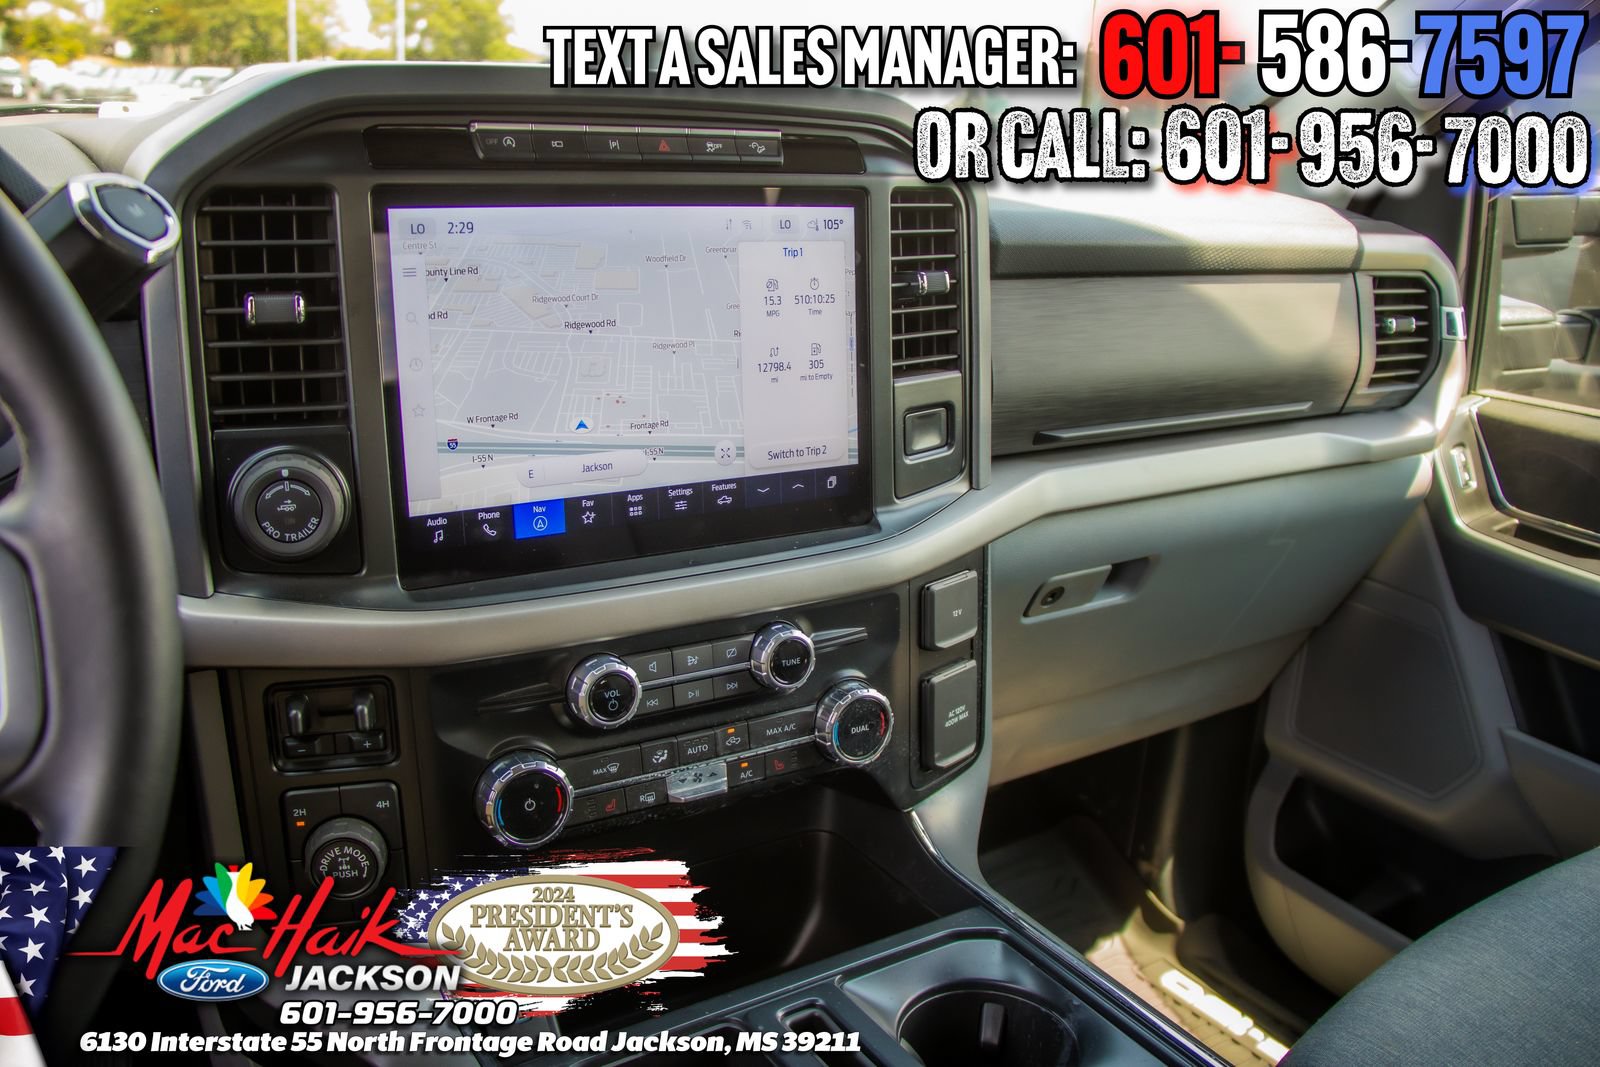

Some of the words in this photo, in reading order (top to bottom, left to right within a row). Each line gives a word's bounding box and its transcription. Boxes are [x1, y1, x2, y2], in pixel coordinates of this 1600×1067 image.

[410, 223, 425, 235] LO
[447, 221, 474, 235] 2:29
[780, 220, 791, 229] LO
[402, 241, 427, 250] Centre
[428, 241, 437, 249] St
[783, 248, 799, 257] Trip
[645, 255, 678, 263] Woodfield
[449, 267, 466, 275] Line
[467, 266, 479, 275] Rd
[532, 295, 571, 304] Ridgewood
[571, 294, 588, 302] Court
[589, 293, 599, 301] Dr
[764, 296, 782, 305] 15.3
[795, 294, 835, 304] 510:10:25
[437, 310, 448, 319] Rd
[564, 321, 605, 330] Ridgewood
[606, 320, 616, 328] Rd
[652, 341, 686, 350] Ridgewood
[758, 362, 792, 373] 12798.4
[809, 360, 824, 369] 305
[815, 373, 832, 381] Empty
[467, 416, 474, 424] W
[475, 414, 508, 424] Frontage
[509, 412, 519, 421] Rd
[630, 421, 659, 430] Frontage
[660, 420, 669, 428] Rd
[768, 449, 794, 461] Switch
[796, 449, 804, 457] to
[806, 446, 821, 458] Trip
[822, 446, 827, 455] 2
[472, 454, 486, 463] I-55
[582, 461, 613, 473] Jackson
[528, 470, 534, 479] E
[711, 482, 737, 491] Features
[668, 487, 693, 498] Settings
[582, 499, 594, 507] Fav
[627, 494, 643, 503] Apps
[533, 505, 546, 513] Nav
[478, 510, 500, 520] Phone
[427, 516, 447, 527] Audio
[261, 521, 281, 539] PRO
[284, 517, 319, 541] TRAILER
[782, 657, 801, 667] TUNE
[604, 690, 621, 698] VOL
[766, 727, 783, 736] MAX
[784, 723, 796, 732] A/C
[851, 724, 870, 734] DUAL
[687, 744, 708, 755] AUTO
[593, 767, 607, 775] MAX
[740, 769, 752, 779] A/C
[376, 800, 390, 809] 4H
[293, 809, 306, 817] 2H
[320, 847, 341, 872] DRIVE
[343, 846, 370, 867] MODE
[333, 869, 359, 878] PUSH
